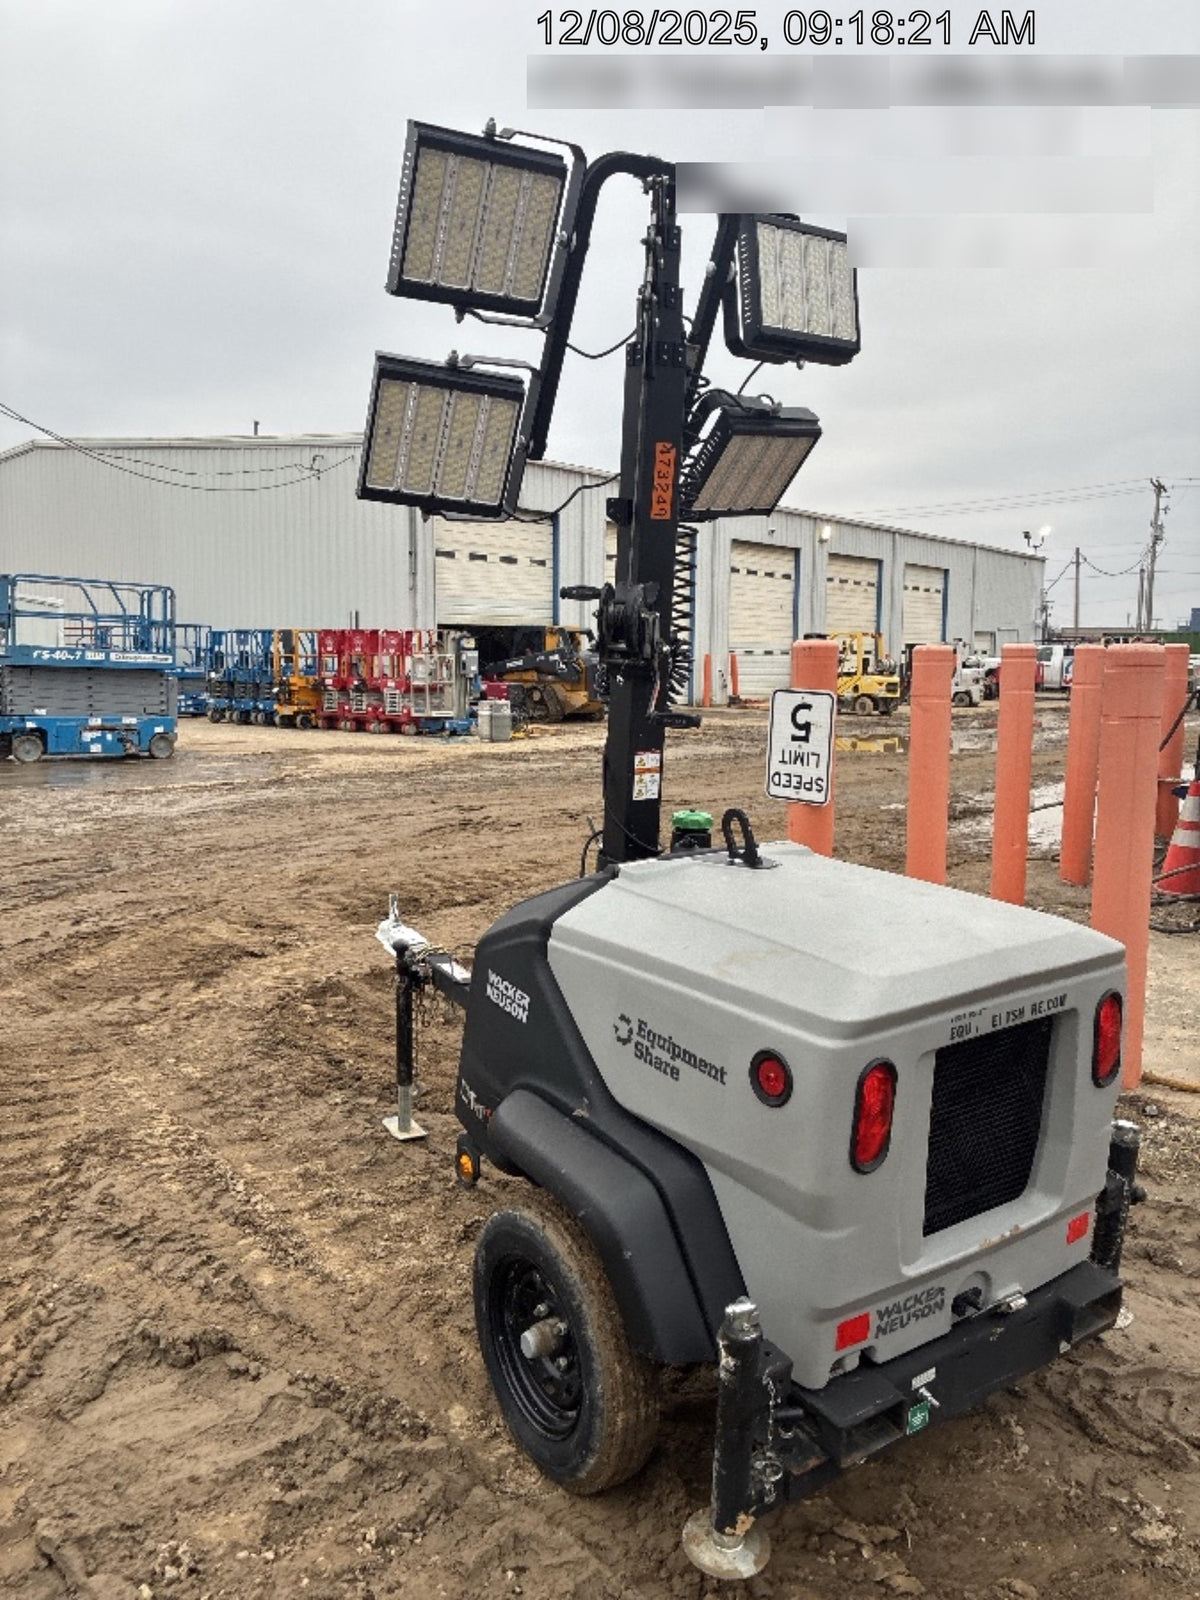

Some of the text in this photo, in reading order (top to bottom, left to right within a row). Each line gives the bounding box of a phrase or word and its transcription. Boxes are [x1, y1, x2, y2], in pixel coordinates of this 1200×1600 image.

[791, 702, 813, 743] 5
[779, 748, 820, 768] LIMIT
[772, 771, 824, 793] SPEED
[486, 983, 529, 1024] NEUSON
[488, 968, 530, 1010] WACKER
[634, 1039, 681, 1082] Share
[637, 1018, 728, 1086] Equipment
[875, 1297, 945, 1339] NEUSON
[876, 1286, 946, 1322] WACKER
